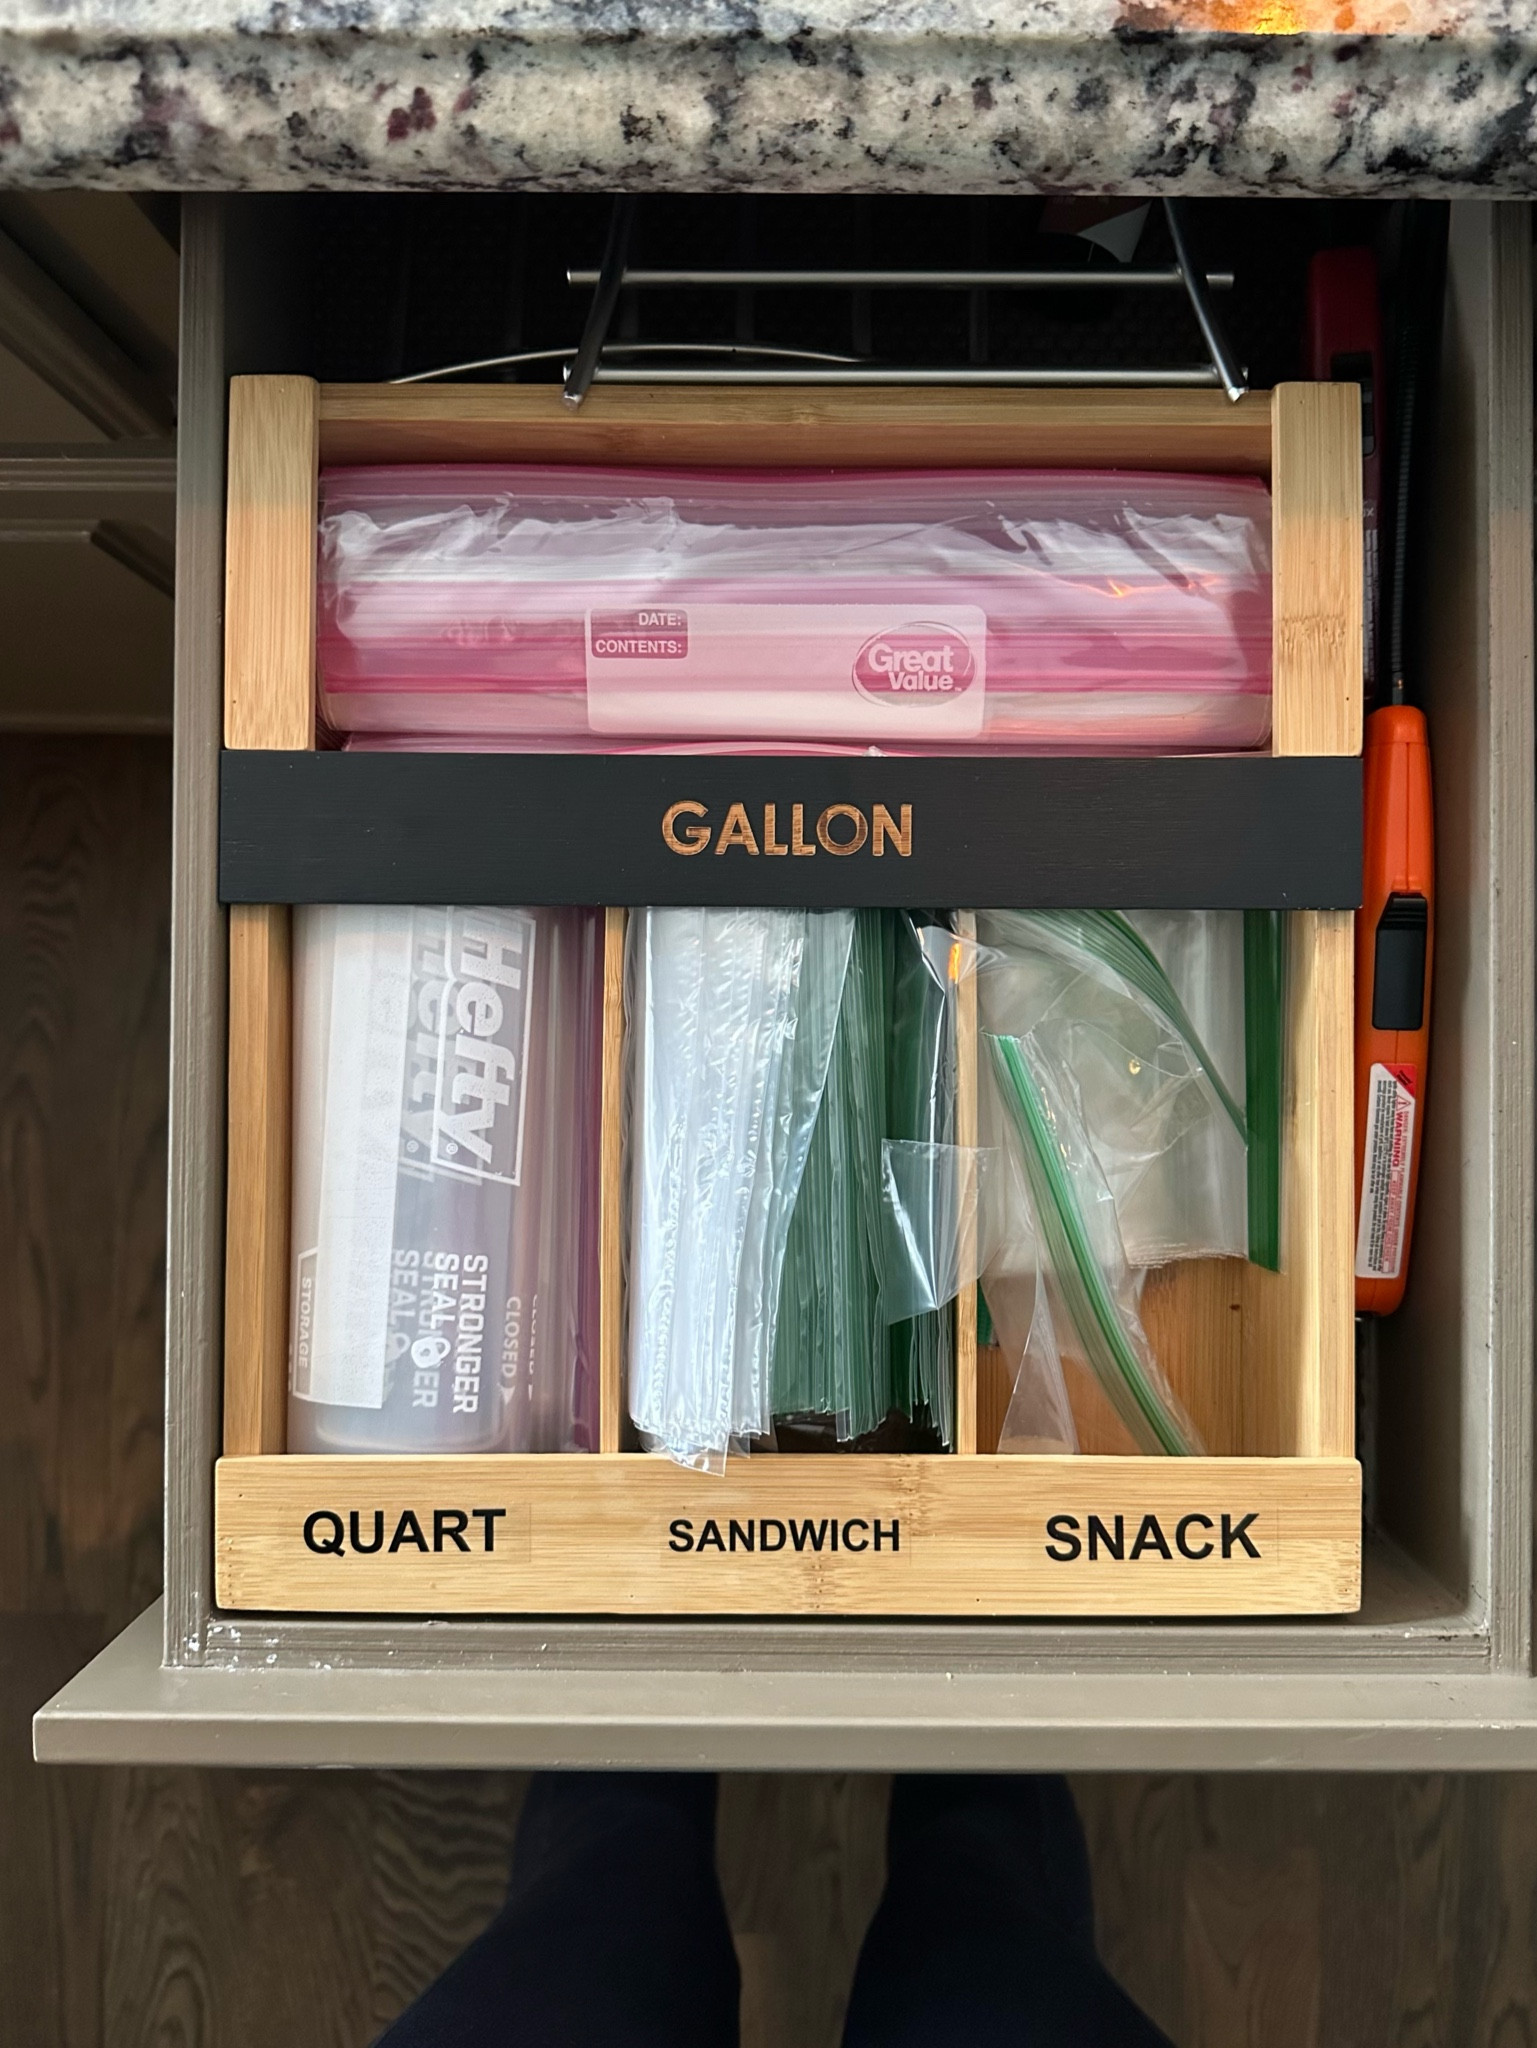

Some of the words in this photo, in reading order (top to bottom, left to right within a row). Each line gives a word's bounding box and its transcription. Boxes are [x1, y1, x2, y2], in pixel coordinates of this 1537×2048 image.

[595, 639, 683, 654] CONTENTS:
[638, 612, 682, 626] DATE:
[868, 643, 954, 673] Great
[888, 671, 954, 691] Value
[661, 800, 913, 857] GALLON
[441, 917, 522, 1164] Hefty
[1392, 1111, 1404, 1167] WARNING
[389, 1248, 420, 1327] SEAL
[430, 1252, 461, 1330] SEAL
[298, 1276, 313, 1369] STORAGE
[452, 1254, 489, 1413] STRONGER
[501, 1296, 522, 1378] CLOSED
[303, 1509, 507, 1557] QUART
[668, 1518, 901, 1552] SANDWICH
[1045, 1513, 1261, 1562] SNACK
